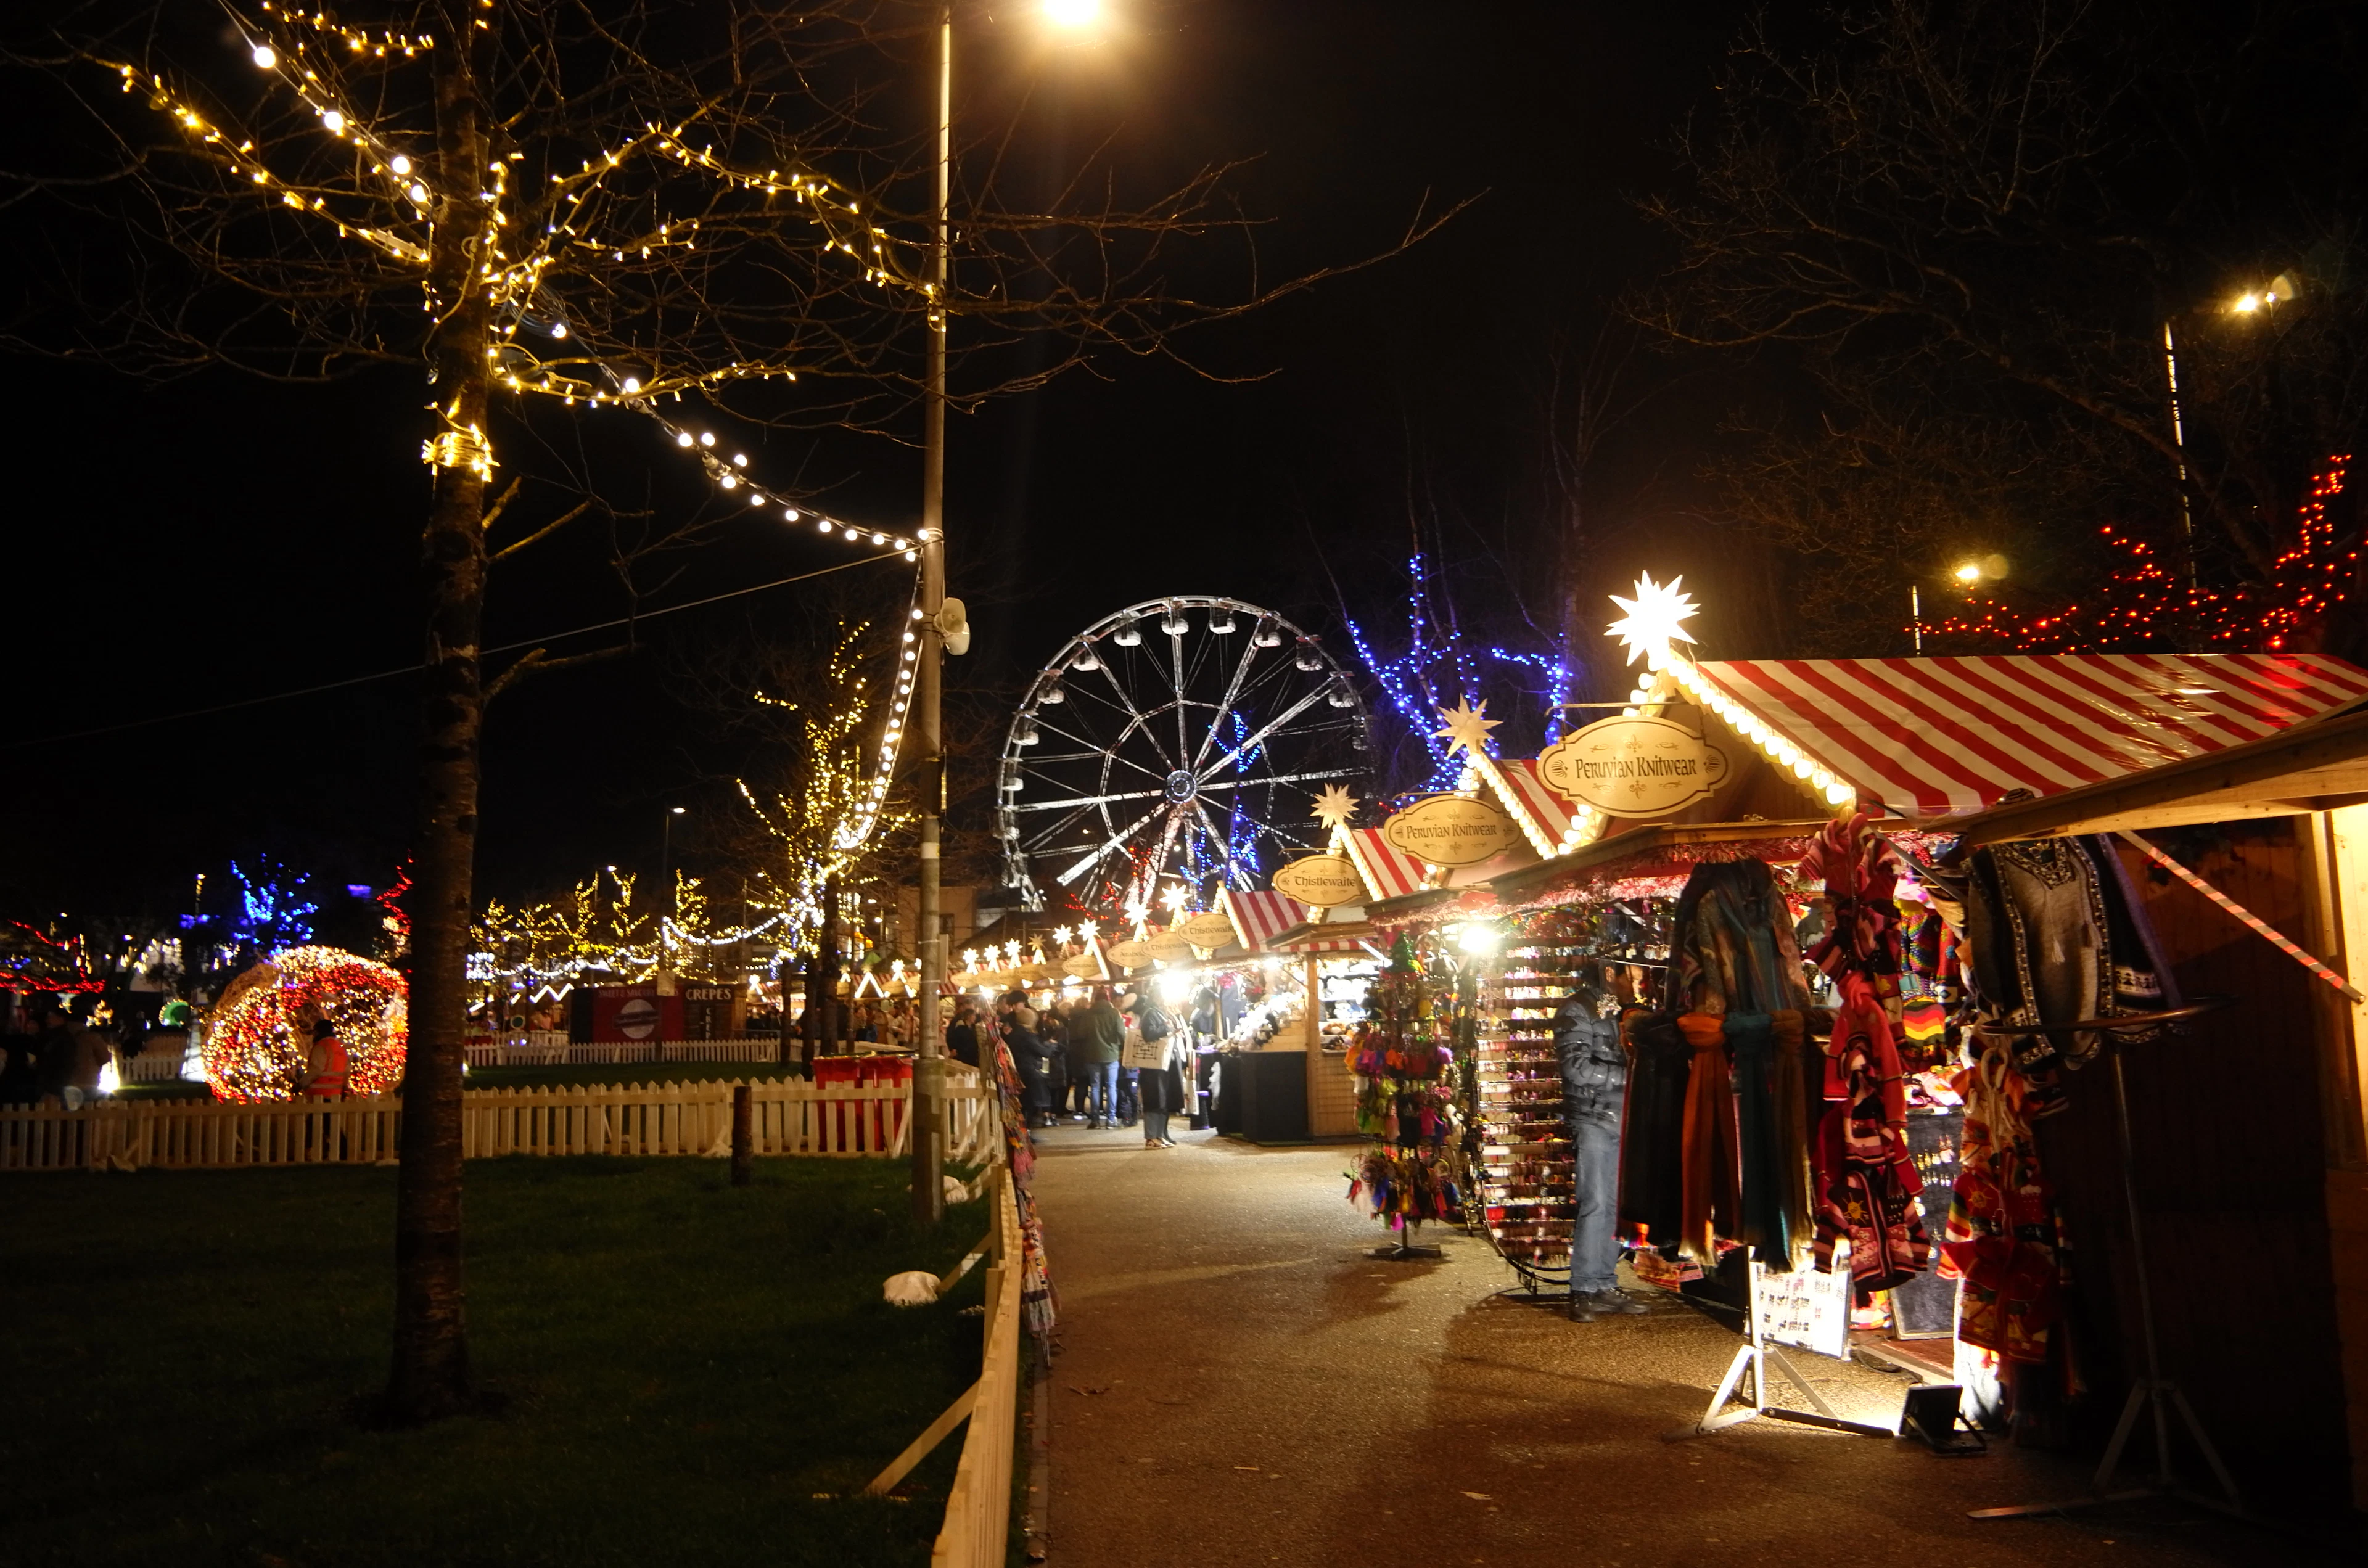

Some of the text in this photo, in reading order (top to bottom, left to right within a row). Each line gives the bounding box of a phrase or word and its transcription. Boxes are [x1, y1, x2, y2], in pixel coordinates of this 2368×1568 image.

[1575, 755, 1698, 778] Peruvian Knitwear
[1406, 823, 1497, 839] Peruvian Knitwear
[1294, 876, 1355, 887] Thistlewaite
[685, 988, 731, 1000] CREPES
